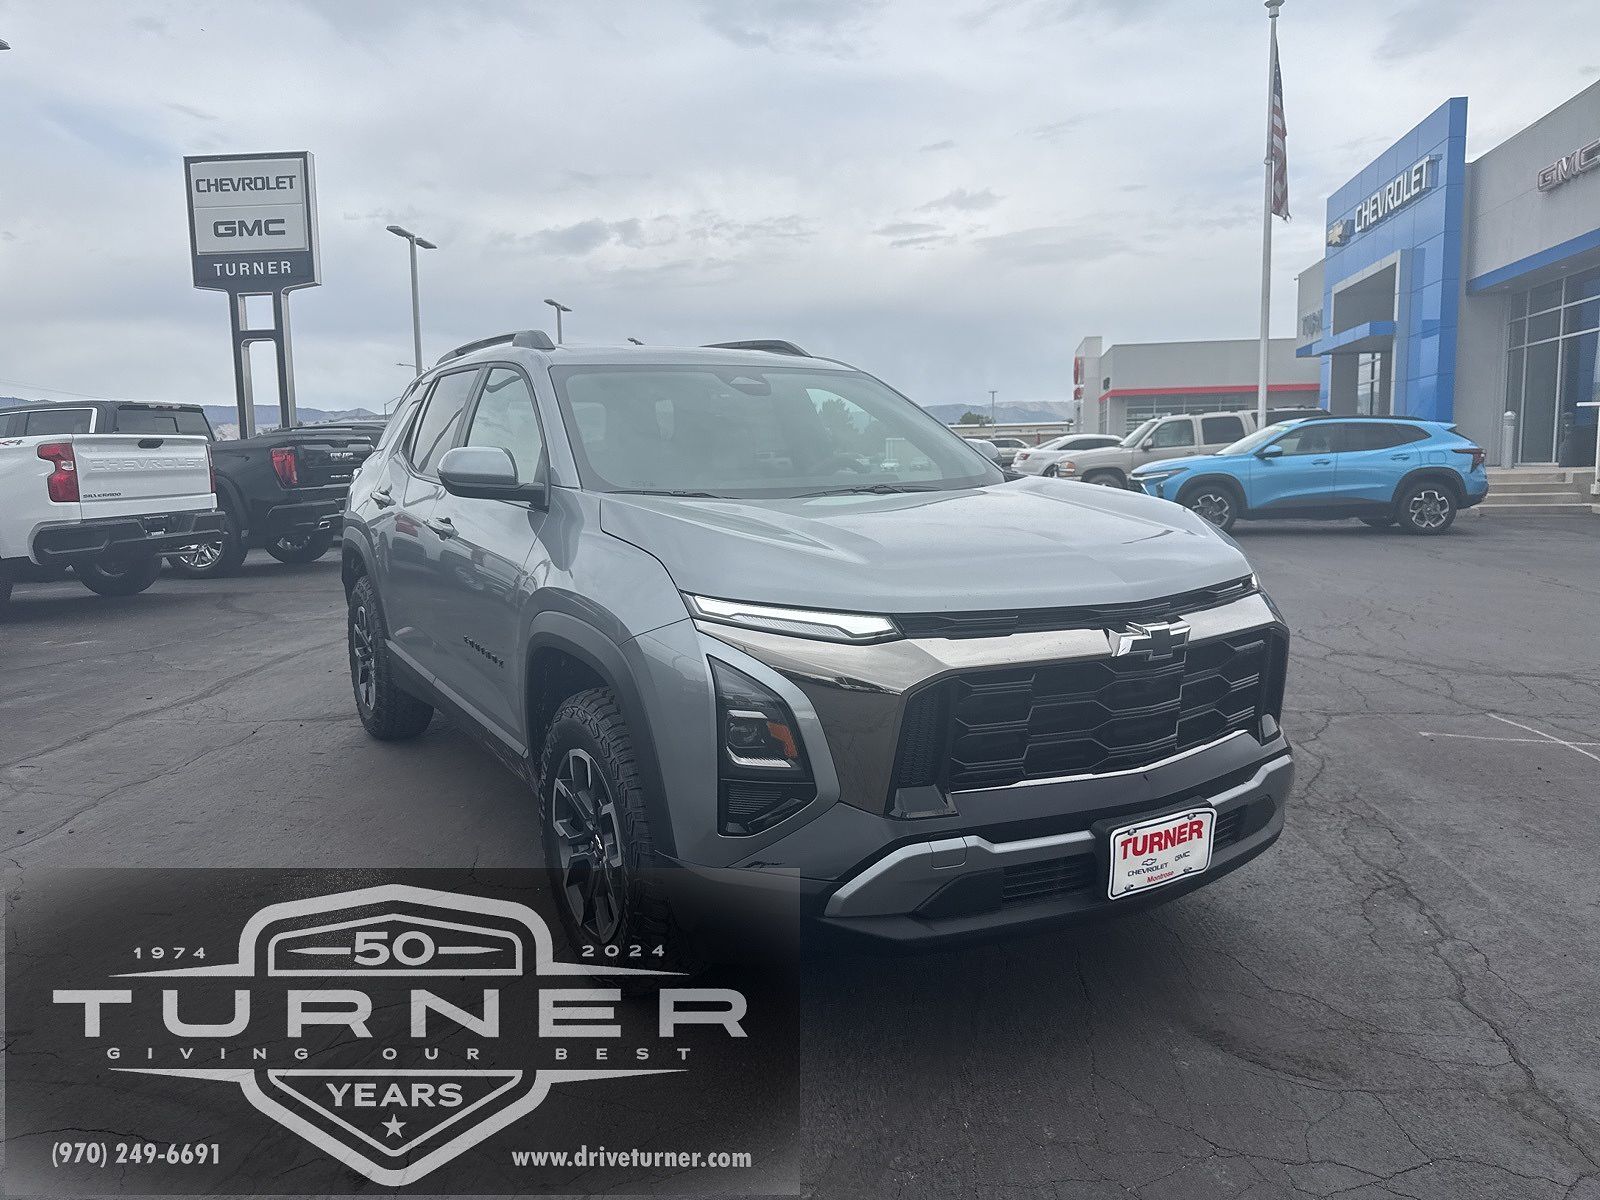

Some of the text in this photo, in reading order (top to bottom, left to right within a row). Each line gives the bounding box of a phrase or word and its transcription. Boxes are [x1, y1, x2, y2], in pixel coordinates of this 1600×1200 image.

[1537, 138, 1600, 192] GMC
[195, 175, 296, 193] CHEVROLET
[1354, 154, 1430, 233] CHEVROLET
[213, 218, 286, 238] GMC
[213, 260, 292, 276] TURNER
[90, 457, 206, 471] CHEVROLET
[82, 491, 122, 499] SILVERADO
[1120, 819, 1204, 860] TURNER
[1174, 850, 1191, 862] GMC
[1127, 861, 1169, 877] CHEVROLET
[1146, 870, 1175, 884] Montrose
